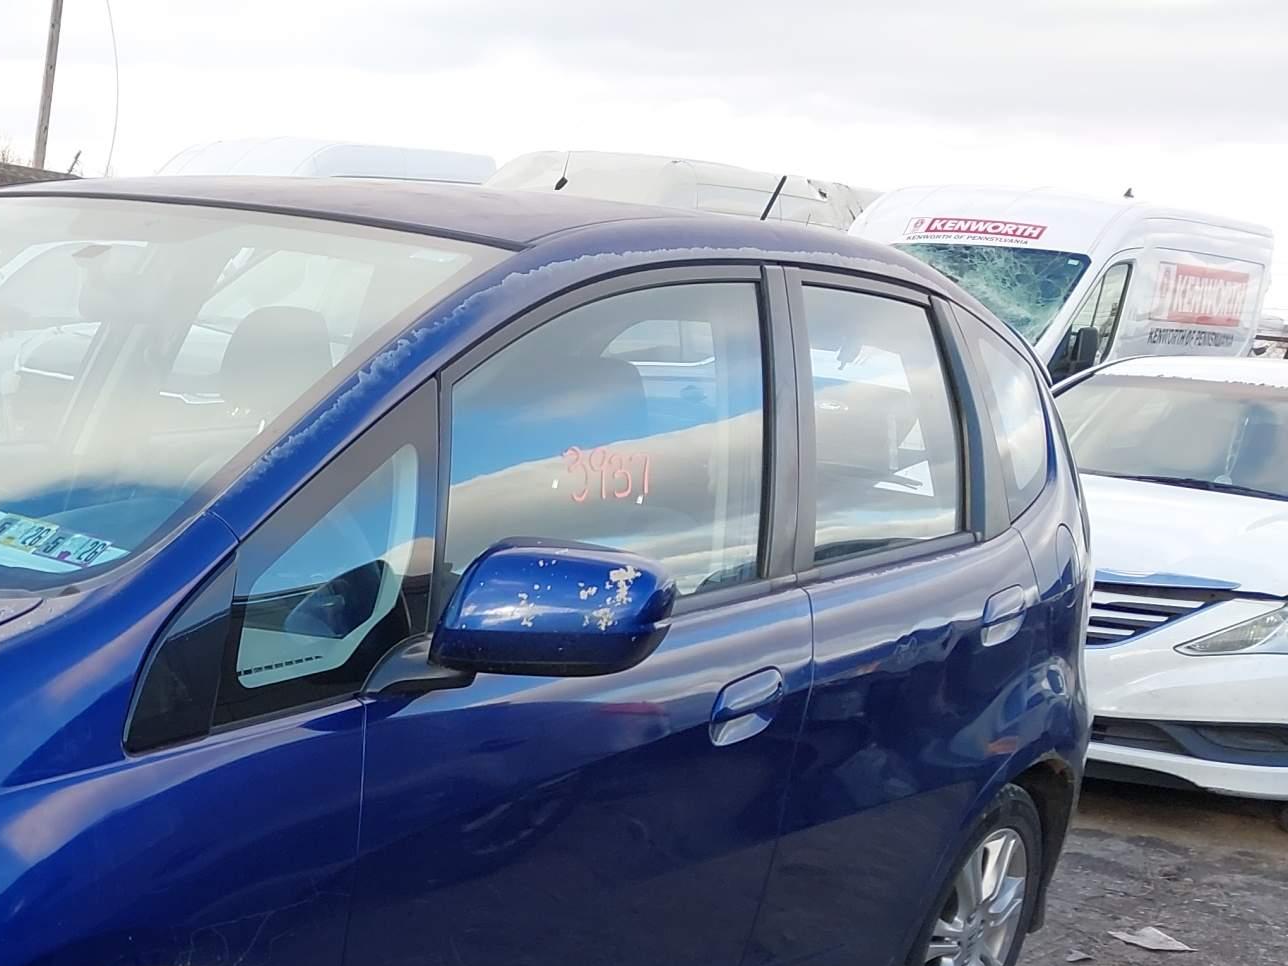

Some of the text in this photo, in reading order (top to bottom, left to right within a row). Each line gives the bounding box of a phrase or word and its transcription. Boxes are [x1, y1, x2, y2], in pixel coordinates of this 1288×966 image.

[906, 233, 952, 241] KENWORTH
[928, 219, 1044, 238] KENWORTH
[1170, 275, 1247, 317] KENWORTH
[561, 446, 650, 502] 3937
